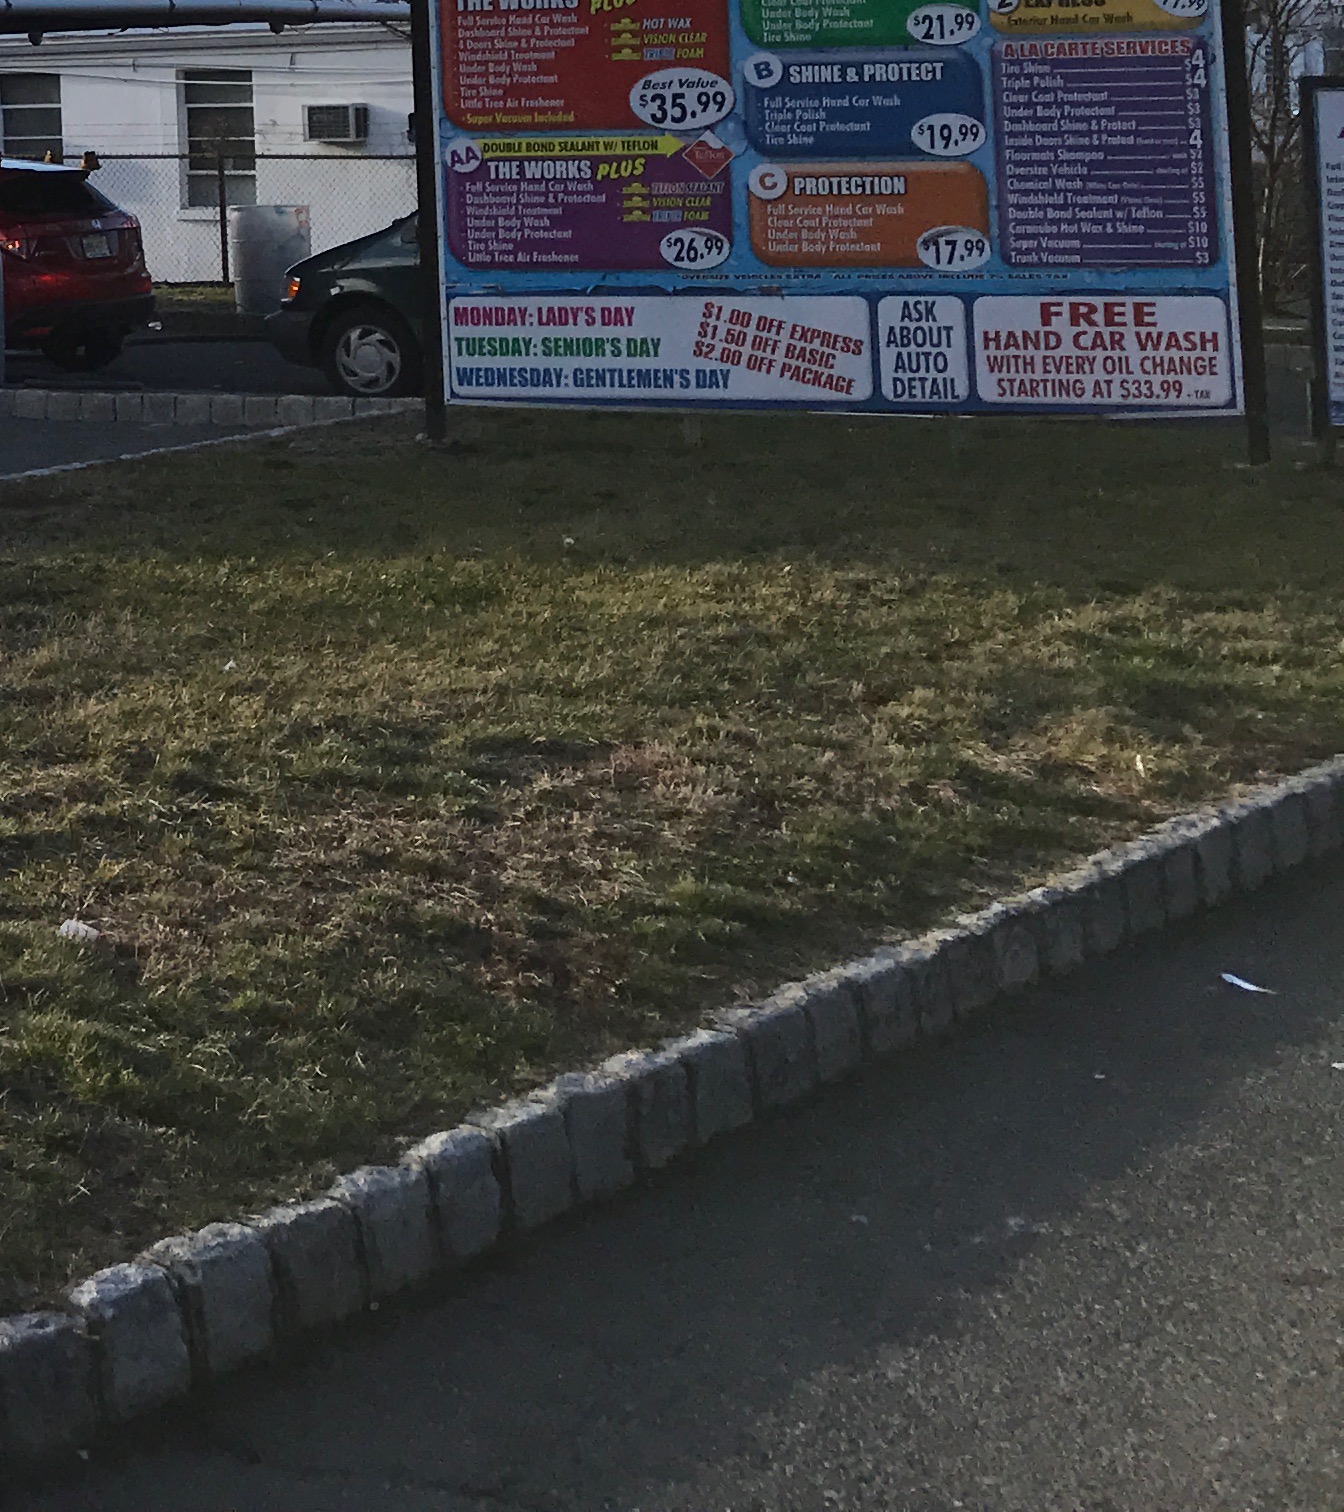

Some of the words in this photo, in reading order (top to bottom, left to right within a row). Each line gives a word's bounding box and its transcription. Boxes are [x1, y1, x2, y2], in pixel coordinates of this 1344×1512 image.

[642, 18, 665, 29] HOT
[668, 18, 692, 28] WAX
[914, 13, 974, 40] $21.99
[1050, 15, 1078, 25] Hand
[1082, 14, 1100, 24] Car
[1103, 12, 1133, 23] Wash
[644, 34, 676, 44] VISION
[679, 32, 707, 43] CLEAR
[676, 48, 704, 59] FOAM
[1003, 43, 1014, 59] A
[1019, 42, 1041, 58] LA
[1044, 41, 1102, 57] CARTE
[1103, 39, 1191, 56] SERVICES
[753, 60, 774, 80] B
[789, 65, 841, 84] SHINE
[847, 67, 859, 82] &
[863, 62, 943, 82] PROTECT
[642, 79, 673, 90] Best
[678, 78, 718, 89] Value
[1034, 76, 1063, 87] Polish
[639, 92, 726, 125] $35.99
[764, 98, 783, 108] Full
[785, 97, 819, 107] Service
[823, 97, 849, 106] Hand
[852, 96, 869, 106] Car
[872, 95, 900, 105] Wash
[764, 111, 792, 122] Triple
[795, 110, 826, 119] Polish
[765, 123, 791, 133] Clear
[794, 122, 816, 132] Coat
[820, 122, 871, 132] Protectant
[918, 123, 980, 150] $19.99
[483, 142, 522, 154] DOUBLE
[526, 142, 555, 153] BOND
[558, 141, 600, 152] SEALANT
[602, 140, 618, 152] W/
[621, 140, 658, 152] TEFLON
[766, 136, 784, 145] Tire
[787, 135, 814, 144] Shine
[450, 147, 480, 168] AA
[487, 161, 521, 180] THE
[524, 160, 592, 179] WORKS
[596, 158, 645, 180] PLUS
[759, 173, 778, 191] C
[794, 176, 906, 195] PROTECTION
[652, 198, 683, 207] VISION
[686, 197, 710, 206] CLEAR
[767, 204, 785, 215] Full
[788, 204, 822, 215] Service
[826, 204, 852, 214] Hand
[856, 204, 873, 214] Car
[876, 204, 904, 214] Wash
[683, 212, 709, 221] FOAM
[666, 238, 724, 264] $26.99
[923, 239, 985, 265] $17.99
[453, 307, 534, 327] MONDAY:
[537, 307, 597, 327] LADY'S
[600, 306, 636, 326] DAY
[900, 300, 937, 322] ASK
[1040, 302, 1158, 327] FREE
[702, 301, 752, 326] $1.00
[755, 314, 787, 335] OFF
[790, 322, 864, 356] EXPRESS
[885, 326, 953, 349] ABOUT
[455, 336, 537, 358] TUESDAY:
[541, 337, 621, 357] SENIOR'S
[626, 337, 661, 357] DAY
[697, 321, 748, 347] $1.50
[751, 333, 781, 354] OFF
[784, 342, 836, 370] BASIC
[983, 331, 1063, 351] HAND
[1072, 331, 1130, 352] CAR
[1137, 331, 1219, 352] WASH
[693, 340, 742, 366] $2.00
[746, 353, 776, 374] OFF
[779, 362, 856, 396] PACKAGE
[893, 351, 948, 374] AUTO
[986, 355, 1037, 374] WITH
[1042, 356, 1097, 376] EVERY
[1103, 356, 1134, 375] OIL
[1140, 356, 1218, 376] CHANGE
[456, 367, 569, 388] WEDNESDAY:
[573, 367, 690, 389] GENTLEMEN'S
[695, 368, 731, 389] DAY
[892, 377, 960, 400] DETAIL
[997, 379, 1087, 399] STARTING
[1091, 379, 1113, 399] AT
[1120, 380, 1183, 400] $33.99
[1194, 390, 1211, 400] TAX
